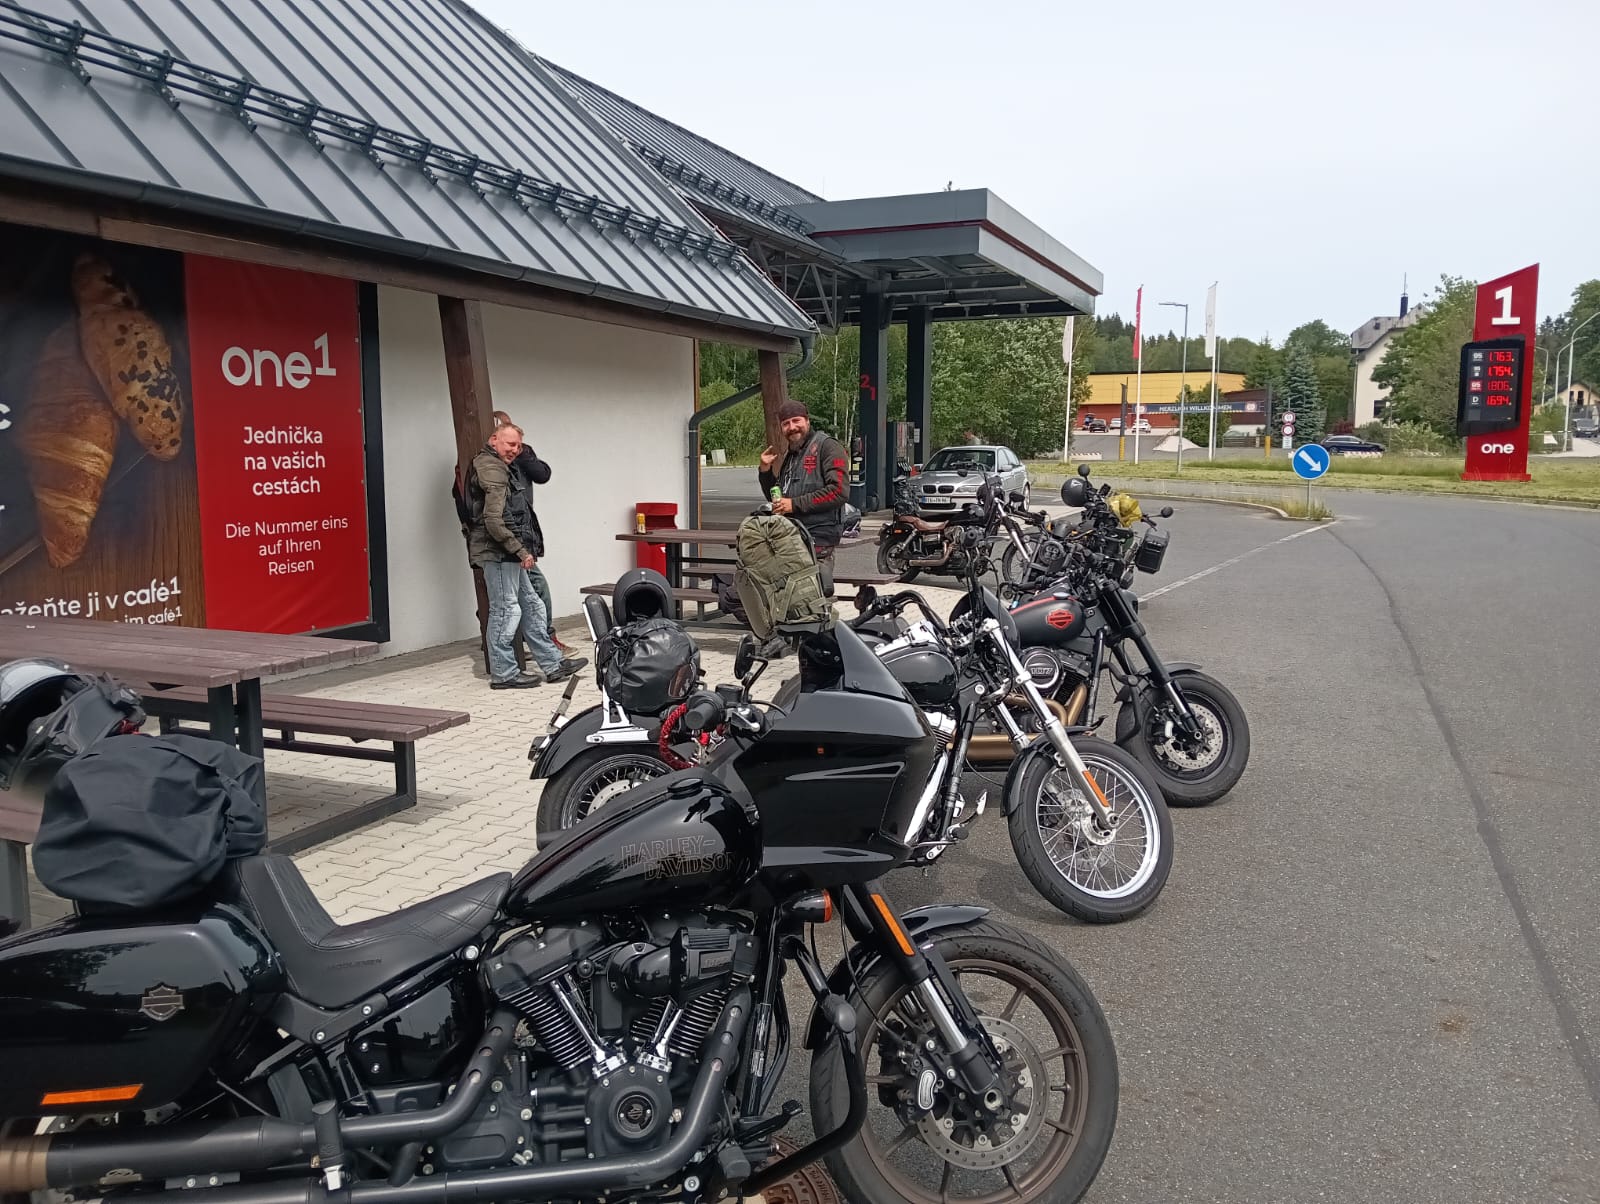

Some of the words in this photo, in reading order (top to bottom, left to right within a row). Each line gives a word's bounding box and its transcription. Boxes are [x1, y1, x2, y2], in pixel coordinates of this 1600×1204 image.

[1492, 285, 1521, 325] 1
[860, 374, 870, 388] 2
[244, 425, 323, 445] Jednička
[1481, 443, 1515, 454] one
[244, 456, 267, 470] na
[271, 450, 326, 470] vašich
[252, 475, 321, 496] cestách
[225, 522, 251, 539] Die
[255, 519, 318, 536] Nummer
[321, 515, 348, 530] eins
[259, 539, 282, 556] auf
[285, 538, 321, 554] Ihren
[268, 558, 315, 576] Reisen
[85, 591, 100, 618] ji
[105, 594, 119, 609] v
